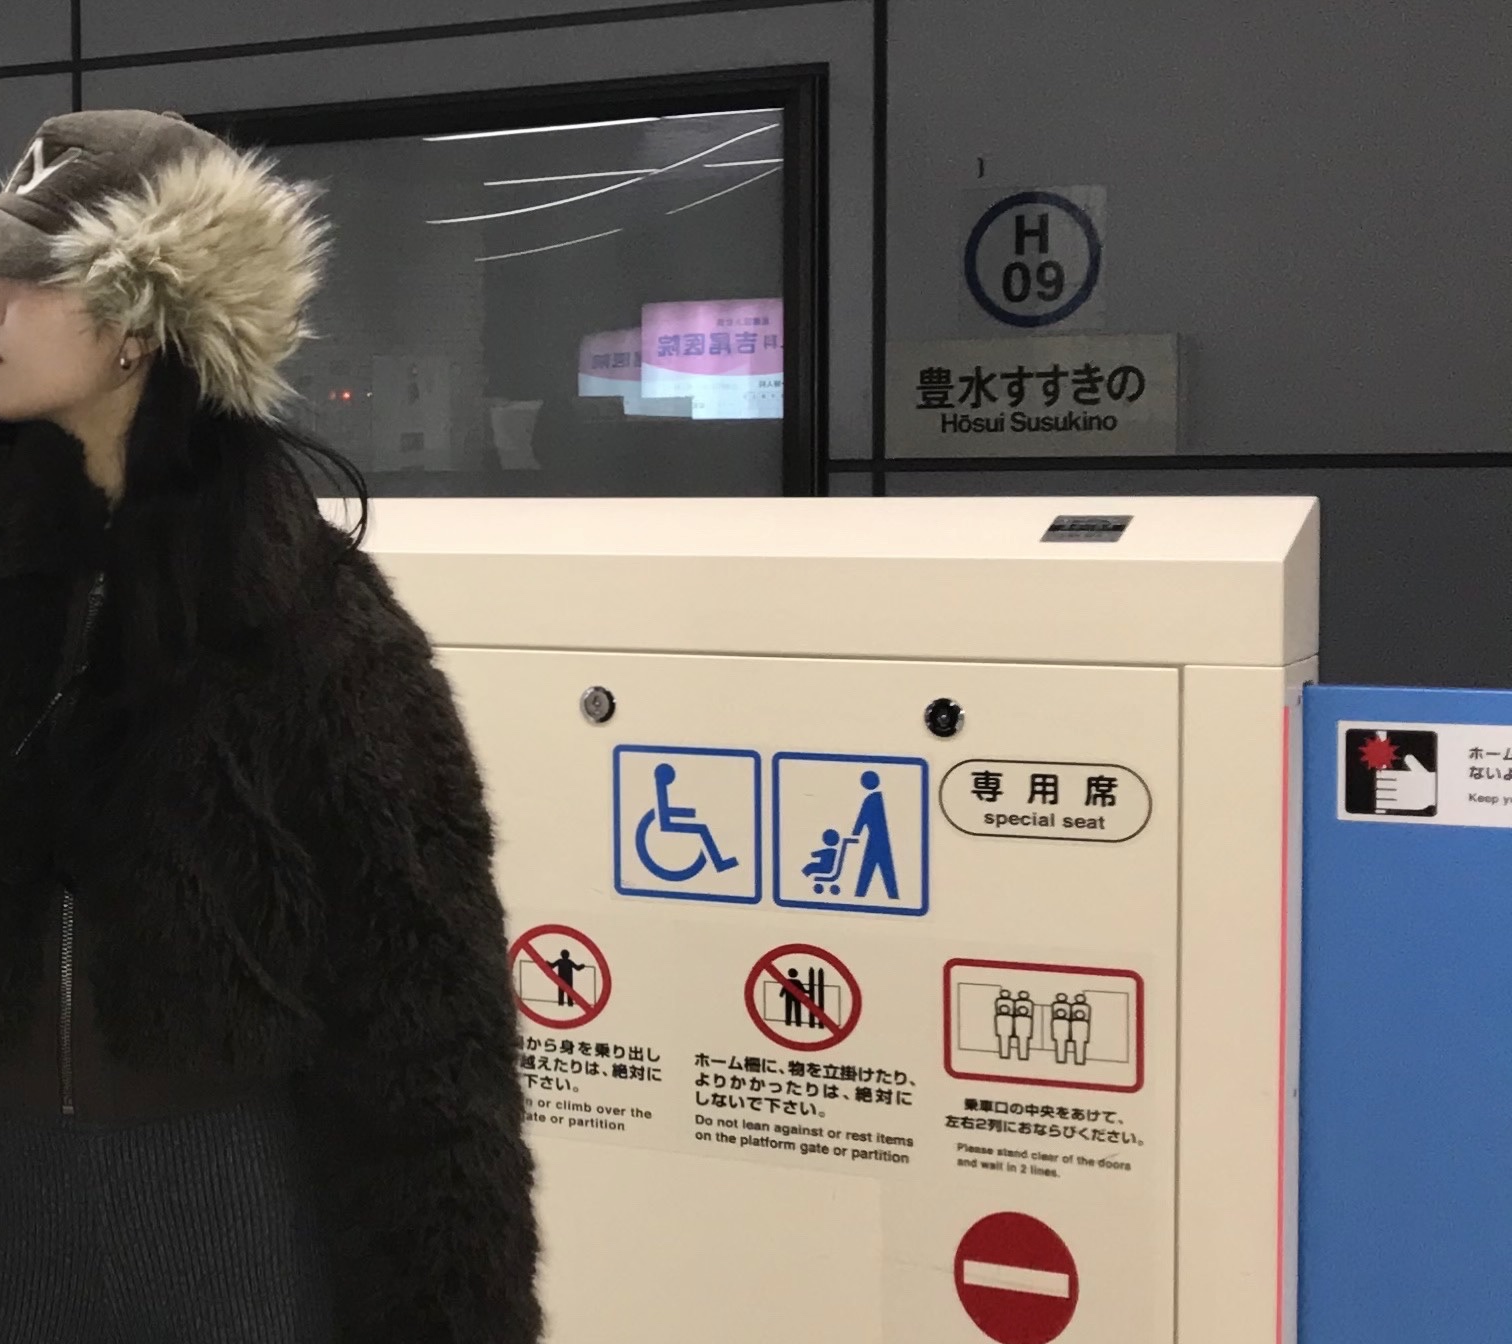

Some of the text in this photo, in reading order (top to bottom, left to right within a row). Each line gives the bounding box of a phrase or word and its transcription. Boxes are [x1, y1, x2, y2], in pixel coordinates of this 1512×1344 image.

[1014, 213, 1050, 256] H
[1002, 259, 1066, 303] 09
[915, 363, 1146, 410] 豊水すすきの
[941, 411, 1118, 433] Hōsui Susukino
[971, 770, 1118, 807] 専用席
[1469, 792, 1499, 805] Keep
[984, 812, 1106, 830] special seat
[520, 1035, 660, 1063] から身を乗り出し
[524, 1073, 579, 1093] 下さい。
[694, 1053, 916, 1087] ホーム柵に、物を立掛けたり、
[694, 1072, 913, 1106] よりかかったりは、絶対に
[537, 1099, 551, 1109] or
[555, 1099, 592, 1113] climb
[596, 1105, 626, 1117] over
[630, 1107, 652, 1120] the
[695, 1090, 826, 1118] しないで下さい。
[964, 1097, 1124, 1125] 乗車口の中央をあけて、
[522, 1111, 626, 1132] ate or partition
[695, 1114, 914, 1148] Do not lean against or rest items
[945, 1114, 1145, 1147] 左右2列におならびください。
[695, 1131, 910, 1164] on the platform gate or partition
[956, 1142, 1131, 1172] Please stand clear of the doors
[957, 1157, 978, 1168] and
[981, 1160, 1003, 1172] wait
[1006, 1162, 1017, 1172] in
[1020, 1163, 1027, 1174] 2
